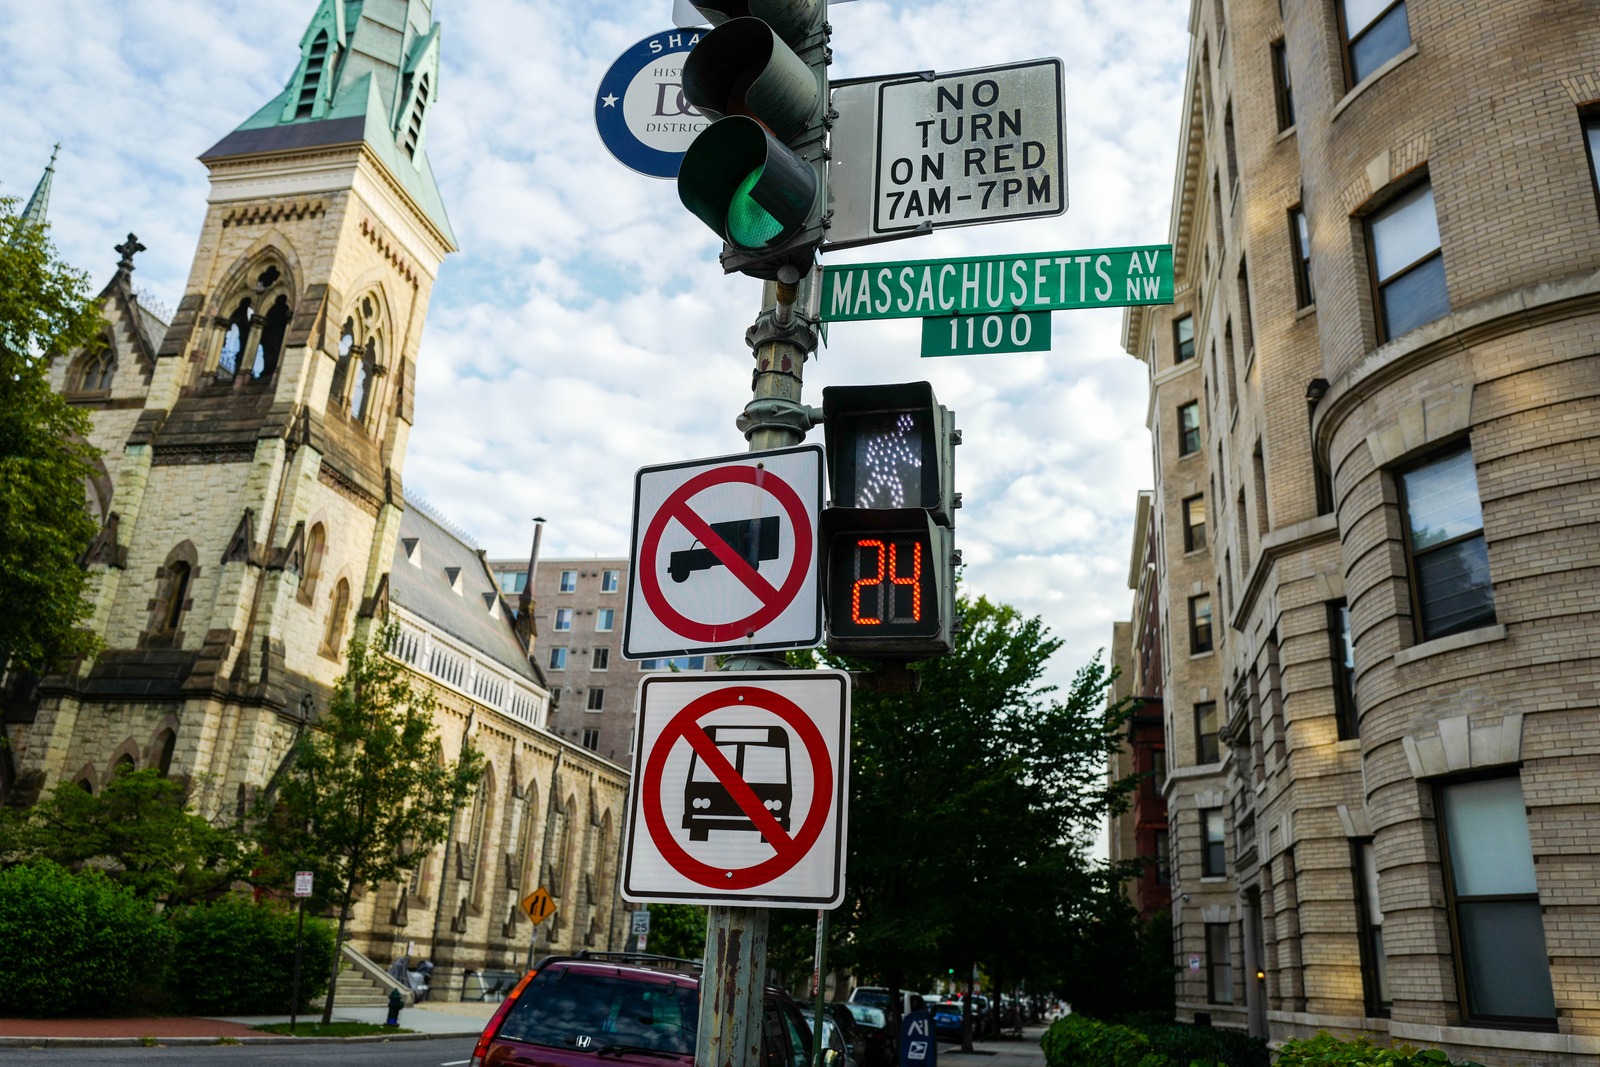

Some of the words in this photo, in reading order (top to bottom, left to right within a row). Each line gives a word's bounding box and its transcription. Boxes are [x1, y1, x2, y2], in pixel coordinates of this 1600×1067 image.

[649, 33, 701, 54] SHA
[653, 68, 683, 77] HIST
[937, 80, 999, 113] NO
[915, 108, 1022, 148] TURN
[890, 152, 945, 185] ON
[963, 140, 1046, 177] RED
[1126, 250, 1160, 276] AV
[830, 254, 1113, 316] MASSACHUSETTS
[1125, 276, 1161, 301] NW
[949, 313, 1033, 350] 1100
[852, 539, 921, 625] 24
[634, 923, 648, 933] 25
